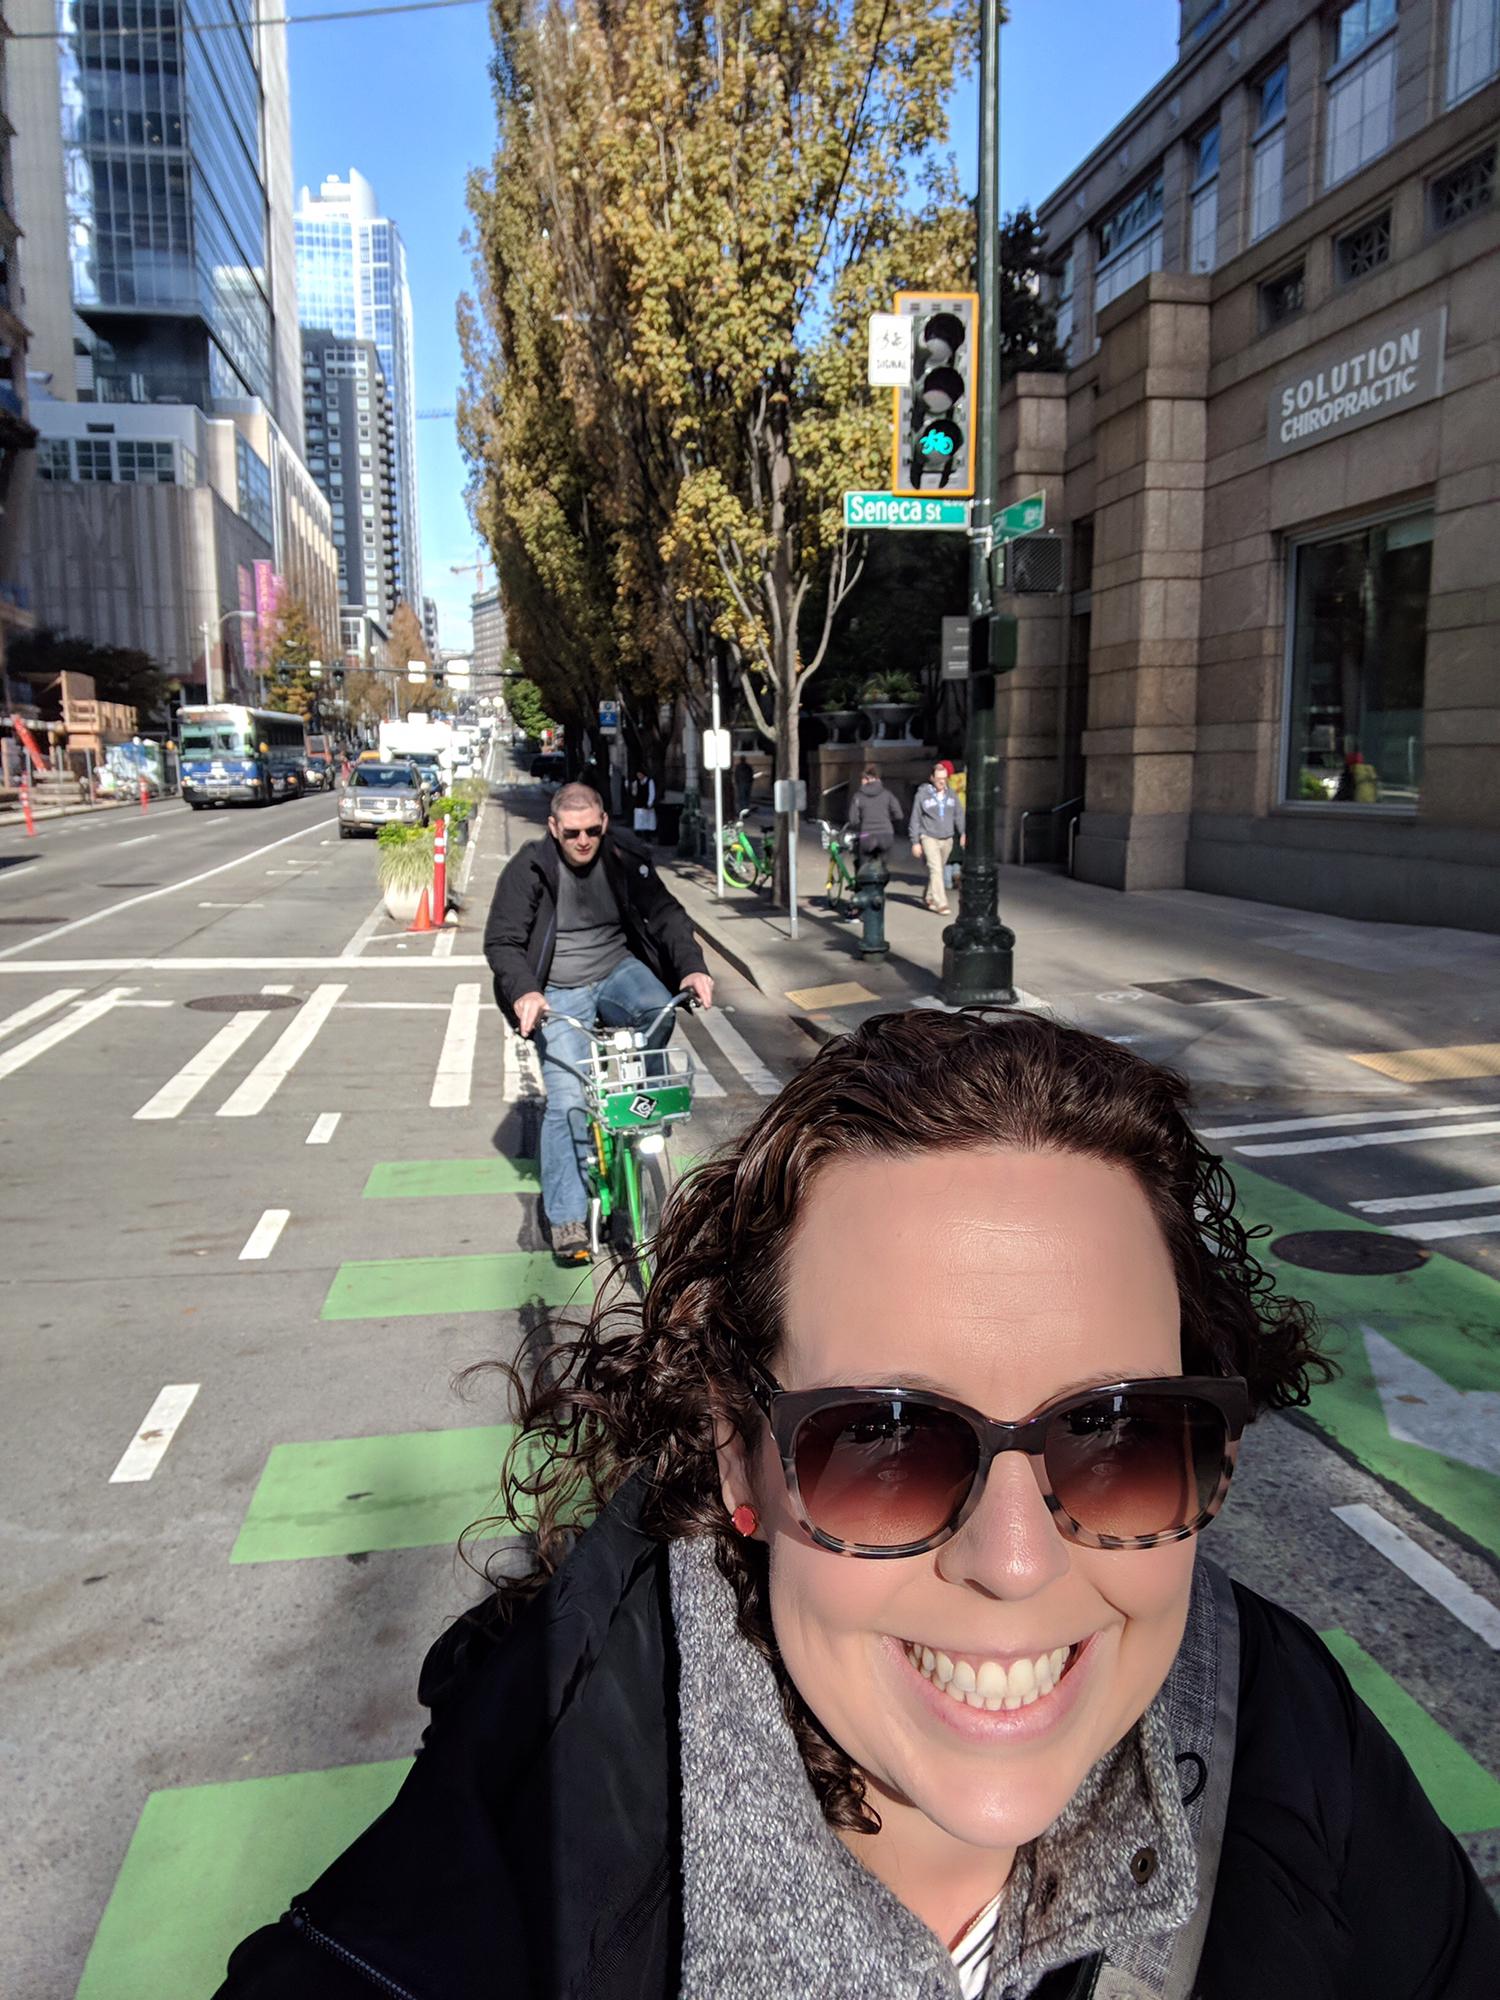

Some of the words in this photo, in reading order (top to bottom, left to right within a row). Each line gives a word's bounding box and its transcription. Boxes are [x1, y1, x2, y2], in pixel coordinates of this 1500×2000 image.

[1280, 366, 1417, 443] CHIROPRACTIC
[1281, 328, 1420, 416] SOLUTION
[850, 496, 922, 521] Seneca
